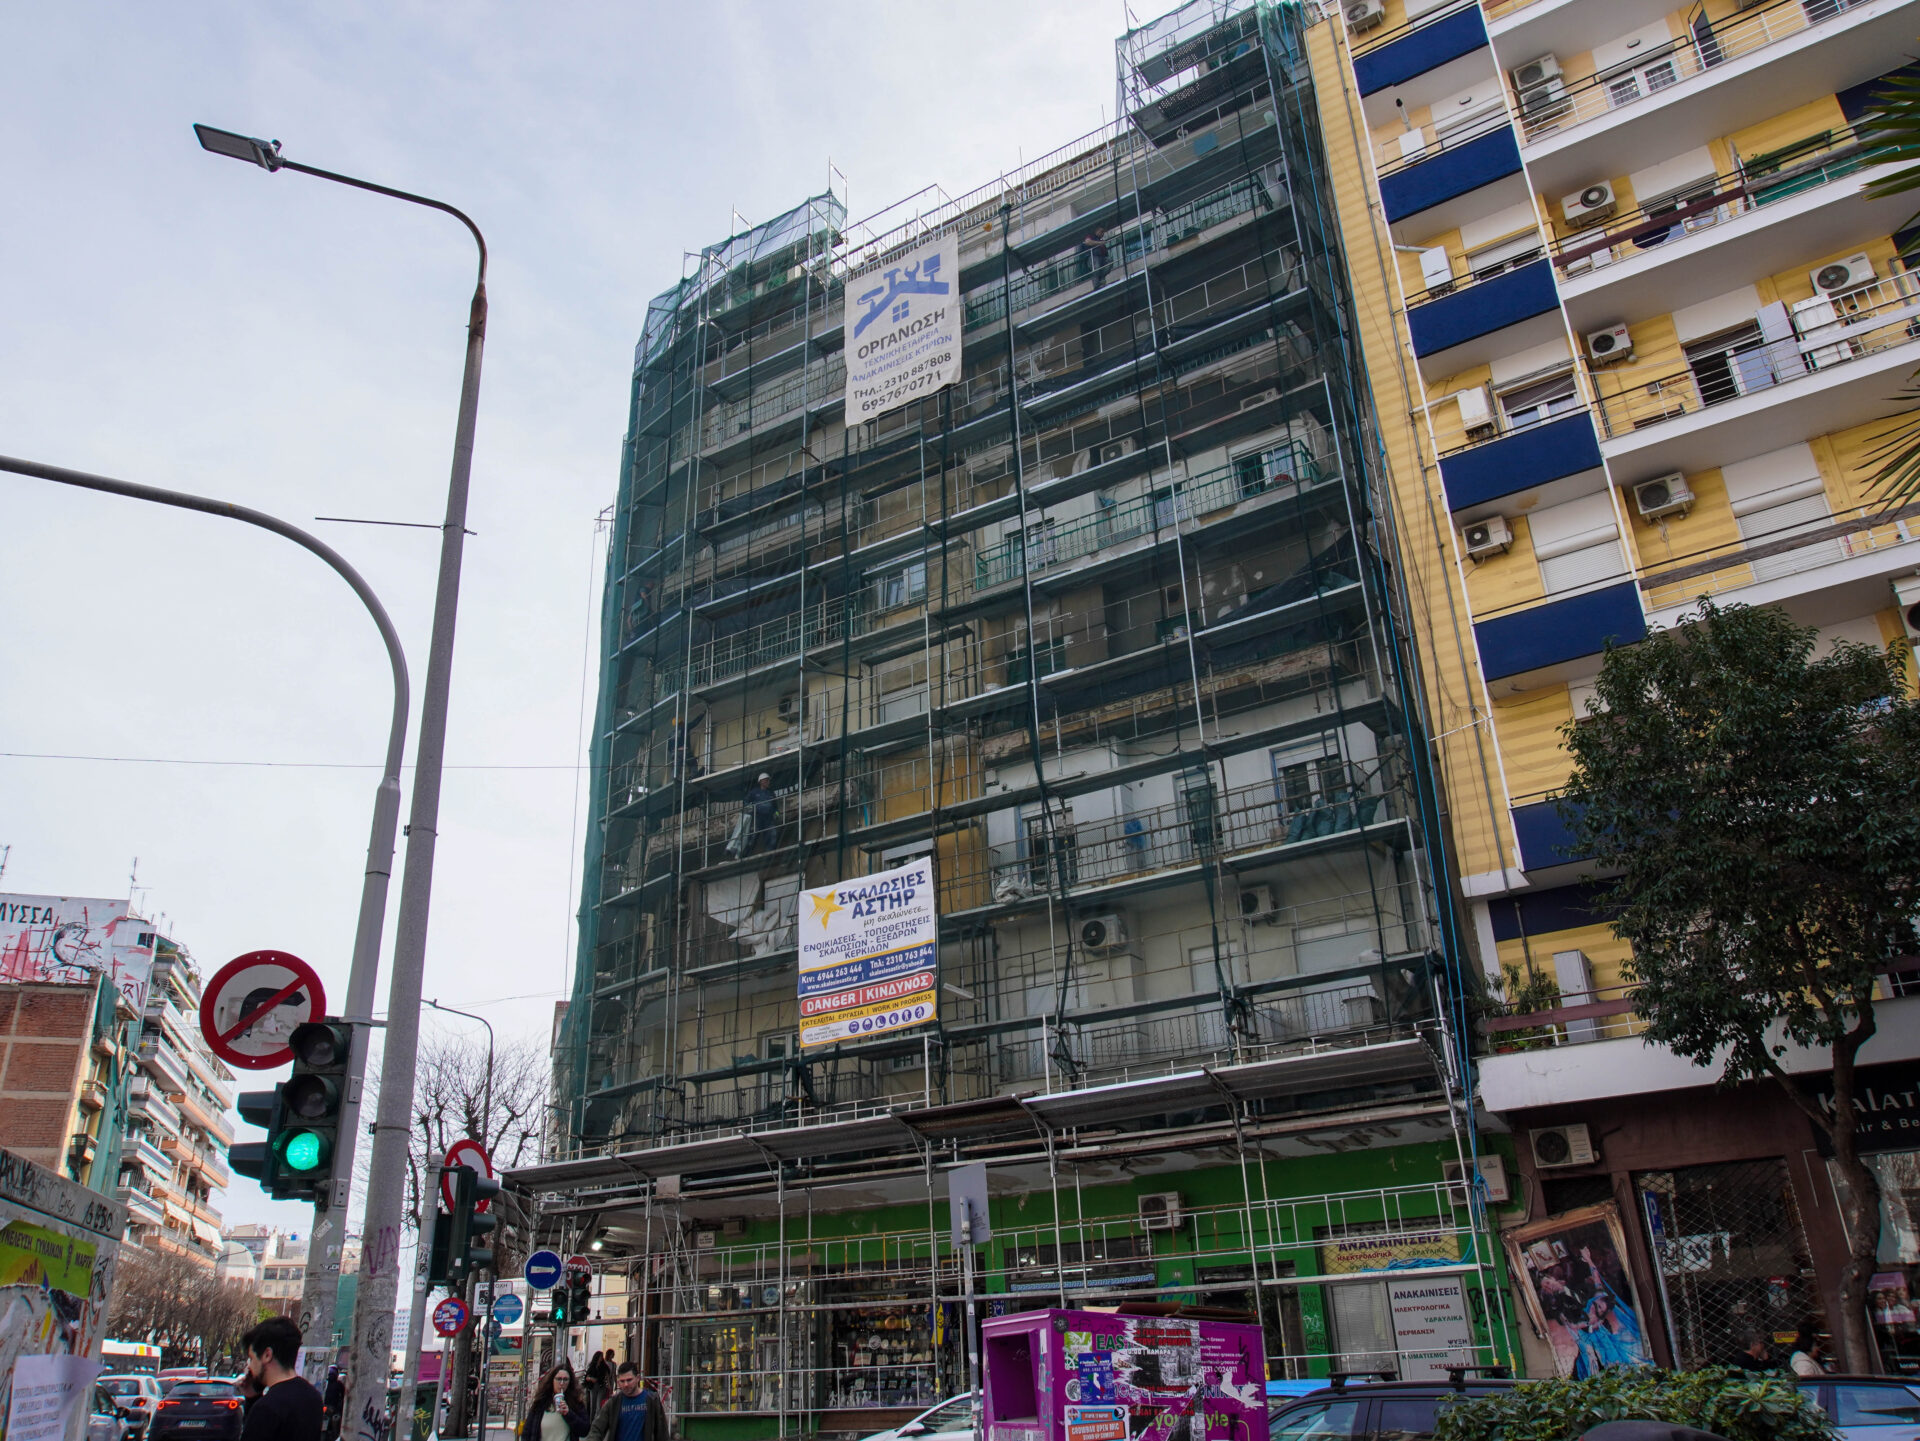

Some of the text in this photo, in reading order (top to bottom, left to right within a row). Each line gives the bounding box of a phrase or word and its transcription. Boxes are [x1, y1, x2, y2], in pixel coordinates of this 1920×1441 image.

[858, 308, 945, 359] ΟΡΓΑΝΩΣΗ
[852, 334, 952, 382] ΑΝΑΚΑΙΝΙΣΕΙΣ ΚΤΙΡΙΩΝ
[864, 328, 939, 369] ΤΕΧΝΙΚΗ ΕΤΑΙΡΕΙΑ
[854, 352, 951, 400] ΤΗΛ.: 2310 887808
[862, 370, 941, 411] 6957670771
[838, 871, 926, 905] ΣΚΑΛΩΣΙΕΣ
[852, 888, 915, 919] ΑΣΤΗΡ
[863, 918, 874, 928] μη
[804, 933, 857, 952] ΕΝΟΙΚΙΑΣΕΙΣ
[864, 915, 931, 938] ΤΟΠΟΘΕΤΗΣΕΙΣ
[819, 939, 868, 958] ΣΚΑΛΩΣΙΩΝ
[876, 927, 917, 944] ΕΞΕΔΡΩΝ
[845, 942, 889, 959] ΚΕΡΚΙΔΩΝ
[886, 954, 903, 966] 2310
[905, 950, 918, 960] 763
[817, 972, 834, 982] 6944
[835, 968, 848, 977] 263
[849, 963, 863, 973] 446
[866, 975, 929, 1001] ΚΙΝΔΥΝΟΣ
[806, 993, 856, 1013] DANGER
[872, 1005, 891, 1013] WORK
[900, 993, 932, 1007] PROGRESS
[801, 1010, 864, 1027] ΕΚΤΕΛΕΙΤΑΙ ΕΡΓΑΣΙΑ
[1817, 1081, 1920, 1114] KALAT
[1881, 1120, 1893, 1130] &
[0, 1229, 33, 1252] ΥΝΕΛΕΥΣΗ
[1393, 1286, 1460, 1300] ΑΝΑΚΑΙΝΙΣΕΙΣ
[1394, 1303, 1451, 1313] ΗΛΕΚΤΡΟΛΟΓΙΚΑ
[1424, 1315, 1464, 1323] ΥΔΡΑΥΛΙΚΑ
[1398, 1328, 1435, 1337] ΘΕΡΜΑΝΣΗ
[1401, 1352, 1448, 1360] ΚΛΙΜΑΤΙΣΜΟΣ
